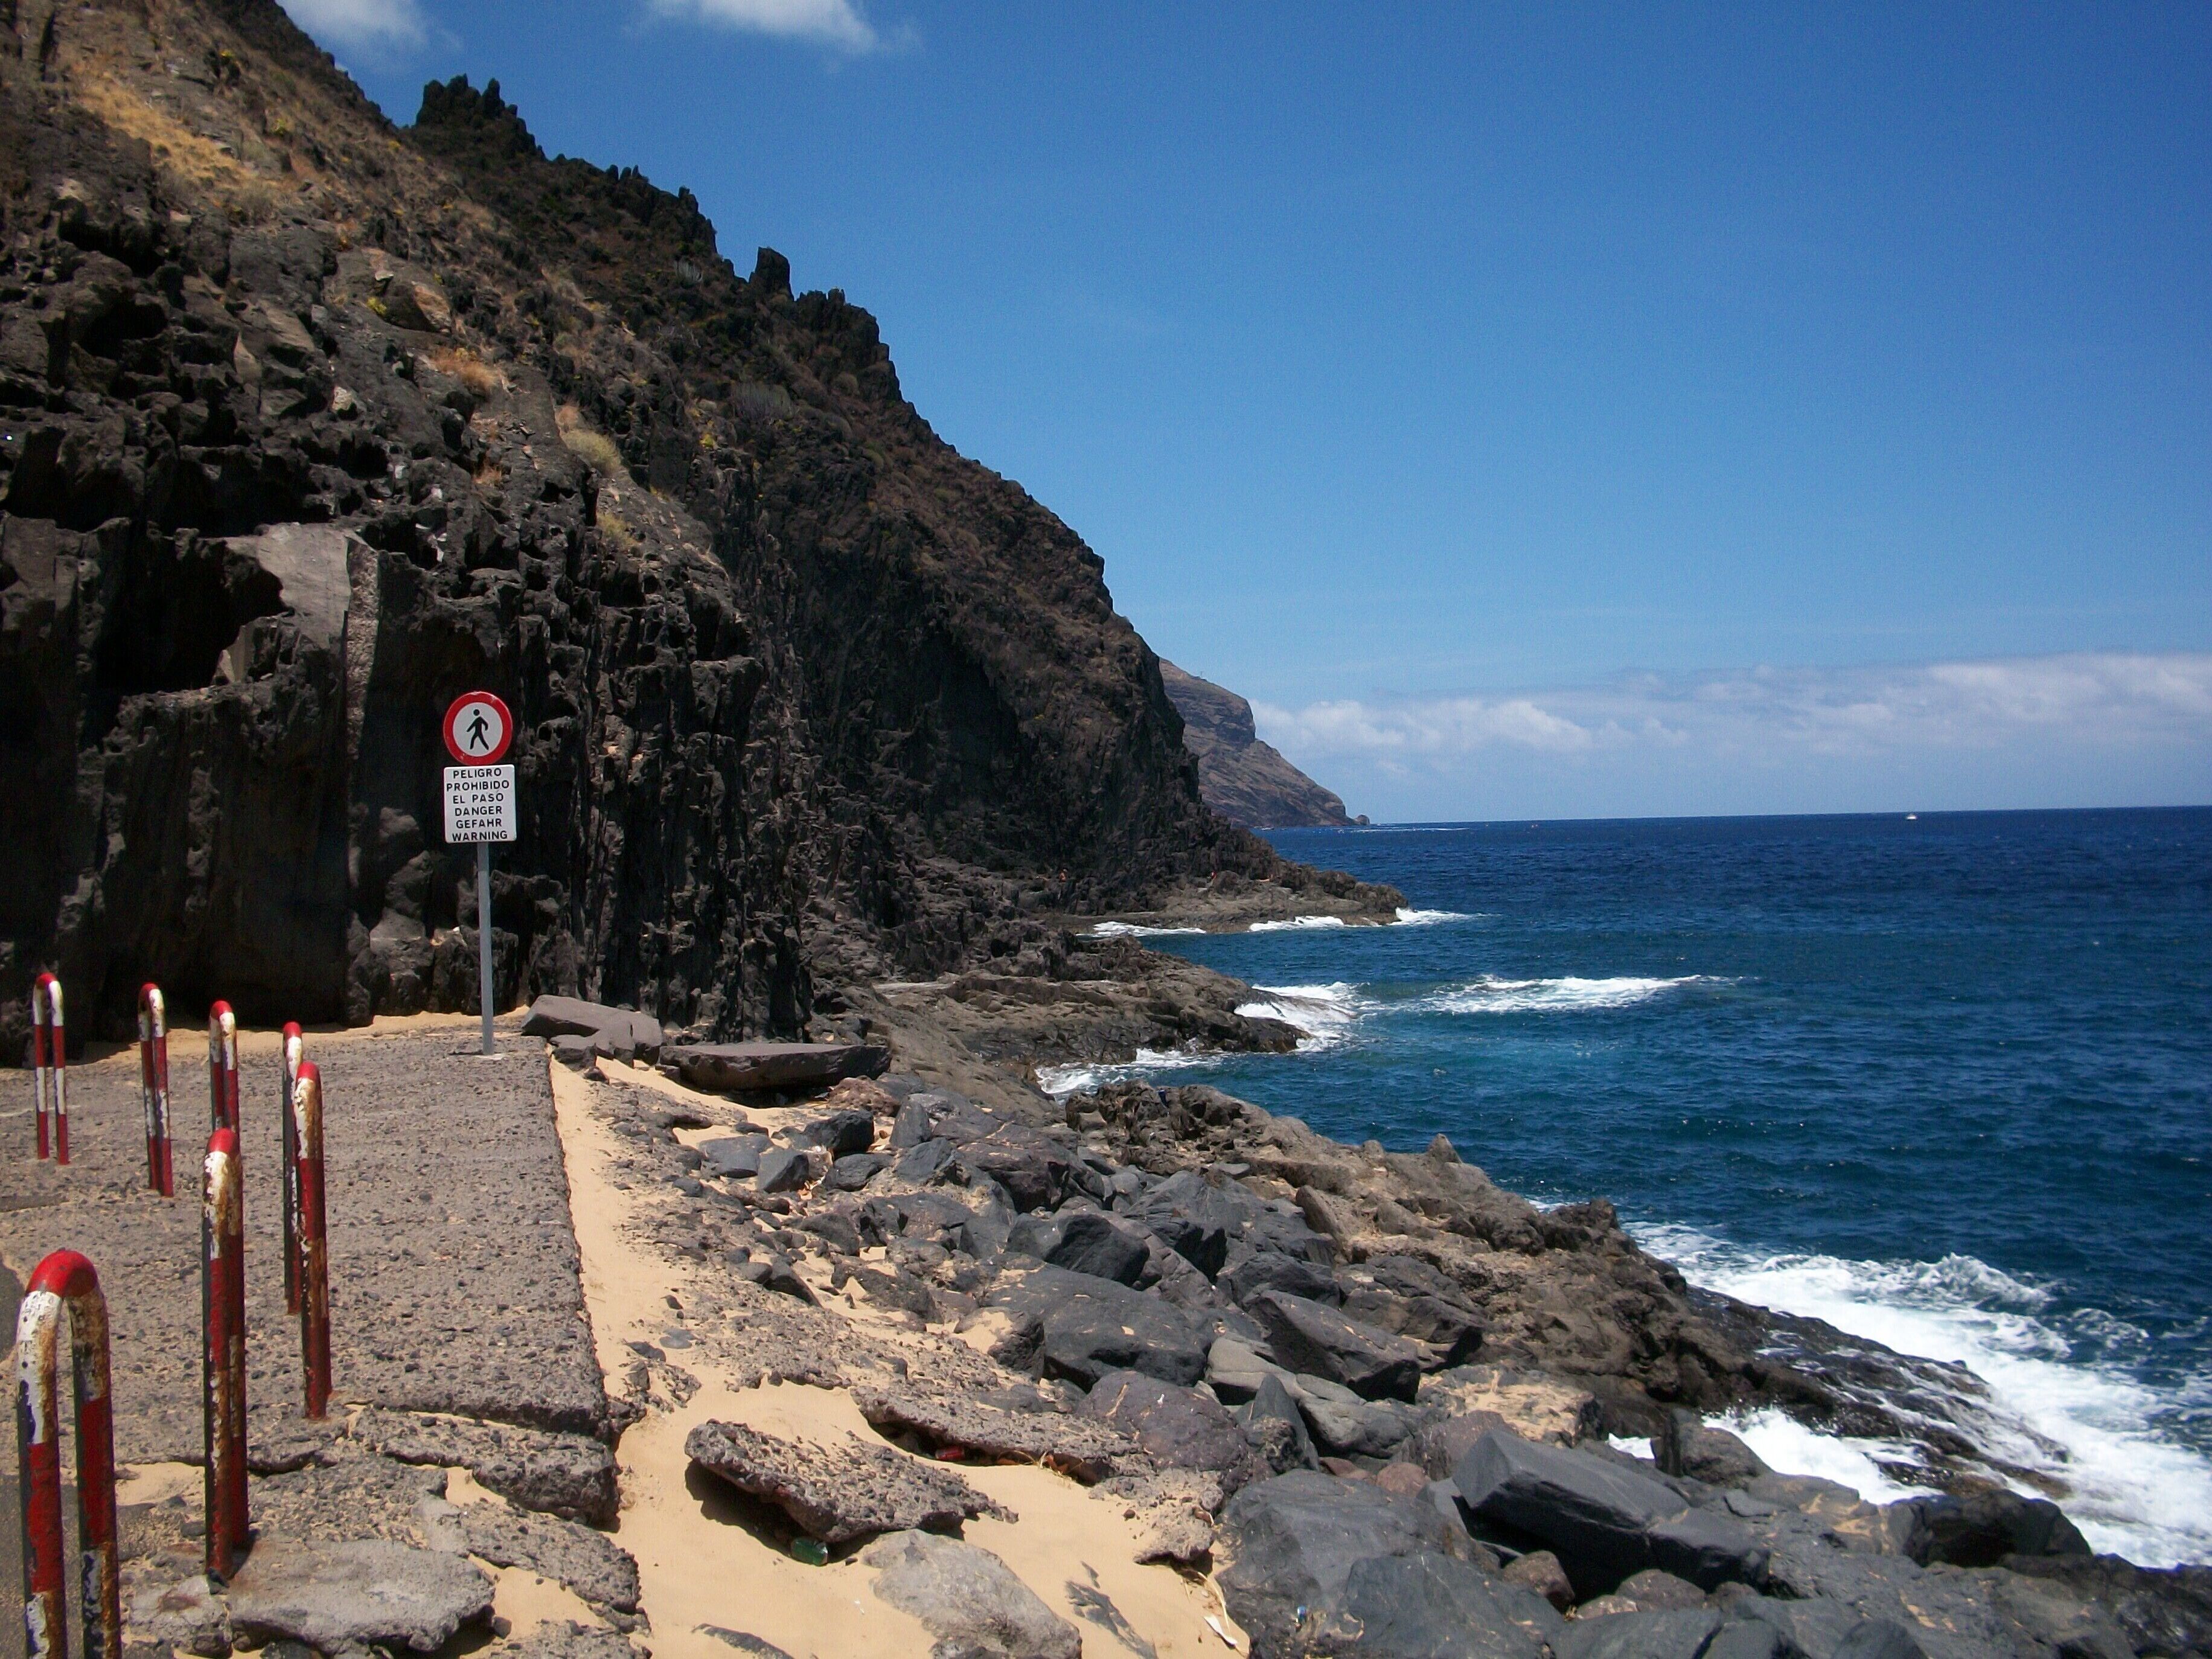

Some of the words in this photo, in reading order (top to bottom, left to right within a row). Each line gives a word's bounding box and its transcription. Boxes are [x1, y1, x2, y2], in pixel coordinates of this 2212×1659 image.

[453, 768, 502, 779] PELIGRO
[447, 780, 510, 791] PROHIBIDO
[453, 795, 465, 804] EL
[472, 793, 503, 802] PASO
[455, 806, 502, 816] DANGER
[456, 818, 502, 829] GEFAHR
[452, 830, 508, 842] WARNING
